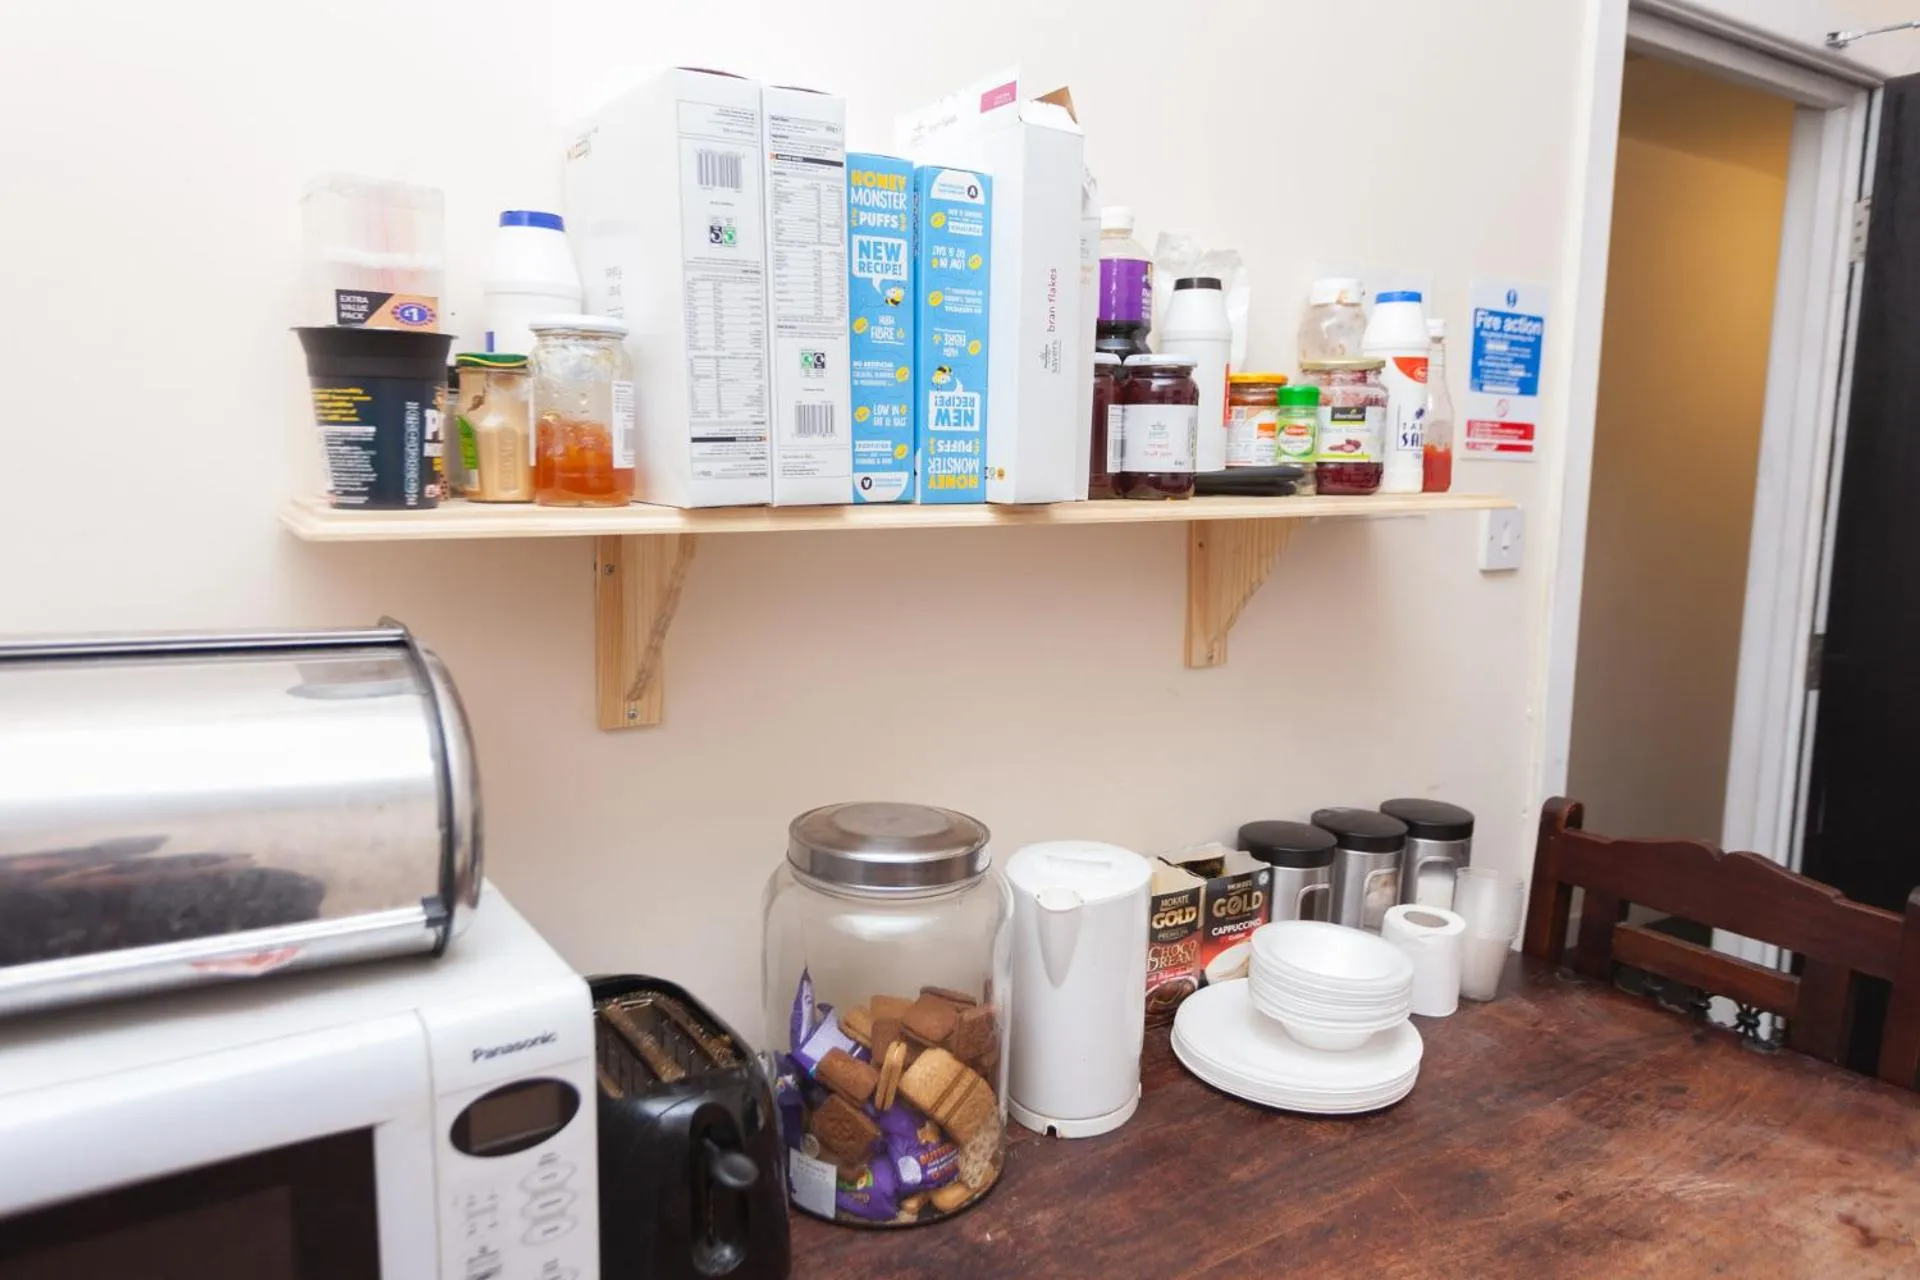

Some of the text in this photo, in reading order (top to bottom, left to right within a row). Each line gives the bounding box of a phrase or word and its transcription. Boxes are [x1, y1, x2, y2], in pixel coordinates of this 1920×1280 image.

[851, 170, 907, 191] HONEY
[850, 187, 908, 210] MONSTER
[859, 211, 899, 228] PUFFS
[858, 240, 902, 263] NEW
[858, 260, 902, 276] RECIPE!
[339, 294, 369, 303] EXTRA
[339, 303, 369, 312] VALUE
[1046, 268, 1057, 333] bran flakes
[340, 311, 364, 320] PACK
[1476, 310, 1502, 331] Fire
[1503, 316, 1544, 336] action
[934, 395, 975, 408] RECIPE!
[934, 408, 975, 427] NEW
[936, 439, 972, 453] PUFFS
[928, 457, 979, 474] MONSTER
[928, 473, 979, 489] HONEY
[1212, 890, 1264, 918] GOLD
[1152, 906, 1197, 930] GOLD
[1211, 917, 1262, 937] CAPPUCCINO
[1148, 939, 1198, 960] CHOCO
[471, 1031, 558, 1063] Panasonic
